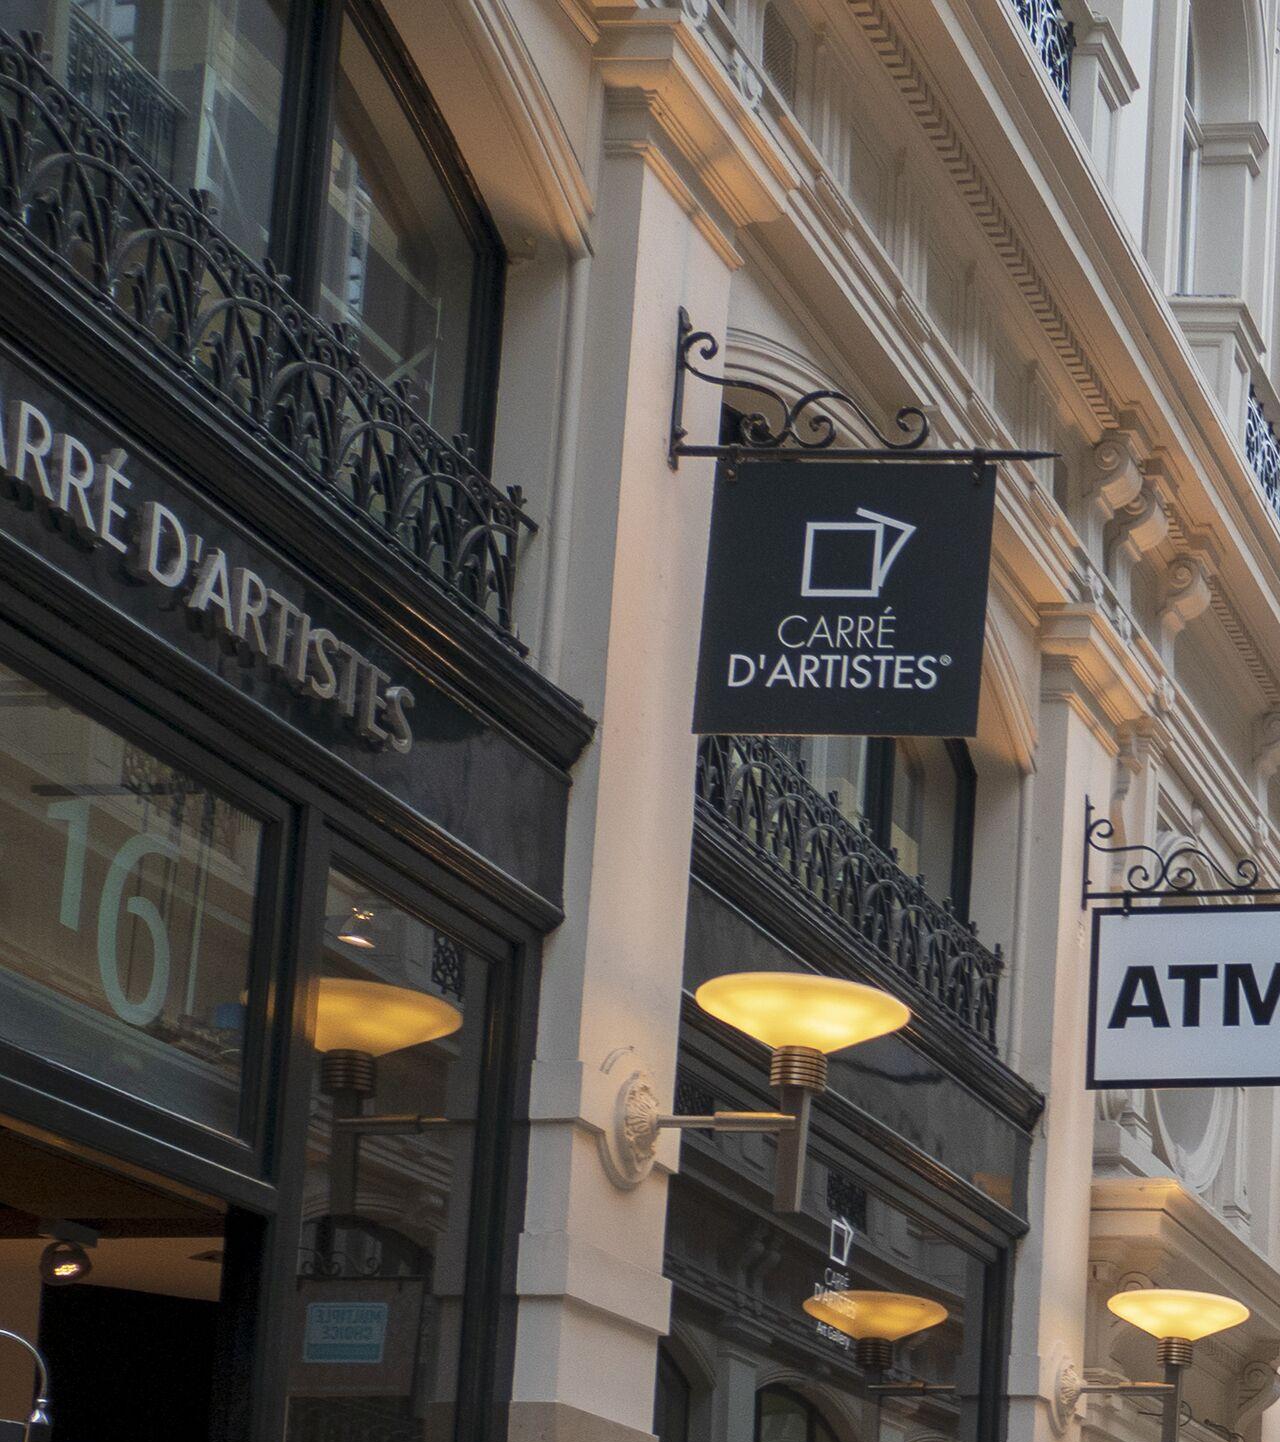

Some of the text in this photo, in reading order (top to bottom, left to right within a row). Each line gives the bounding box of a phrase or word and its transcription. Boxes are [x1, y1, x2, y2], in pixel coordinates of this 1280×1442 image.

[0, 399, 416, 754] RRÉ D'ARTISTES
[777, 607, 897, 649] CARRÉ
[46, 797, 171, 1027] 16
